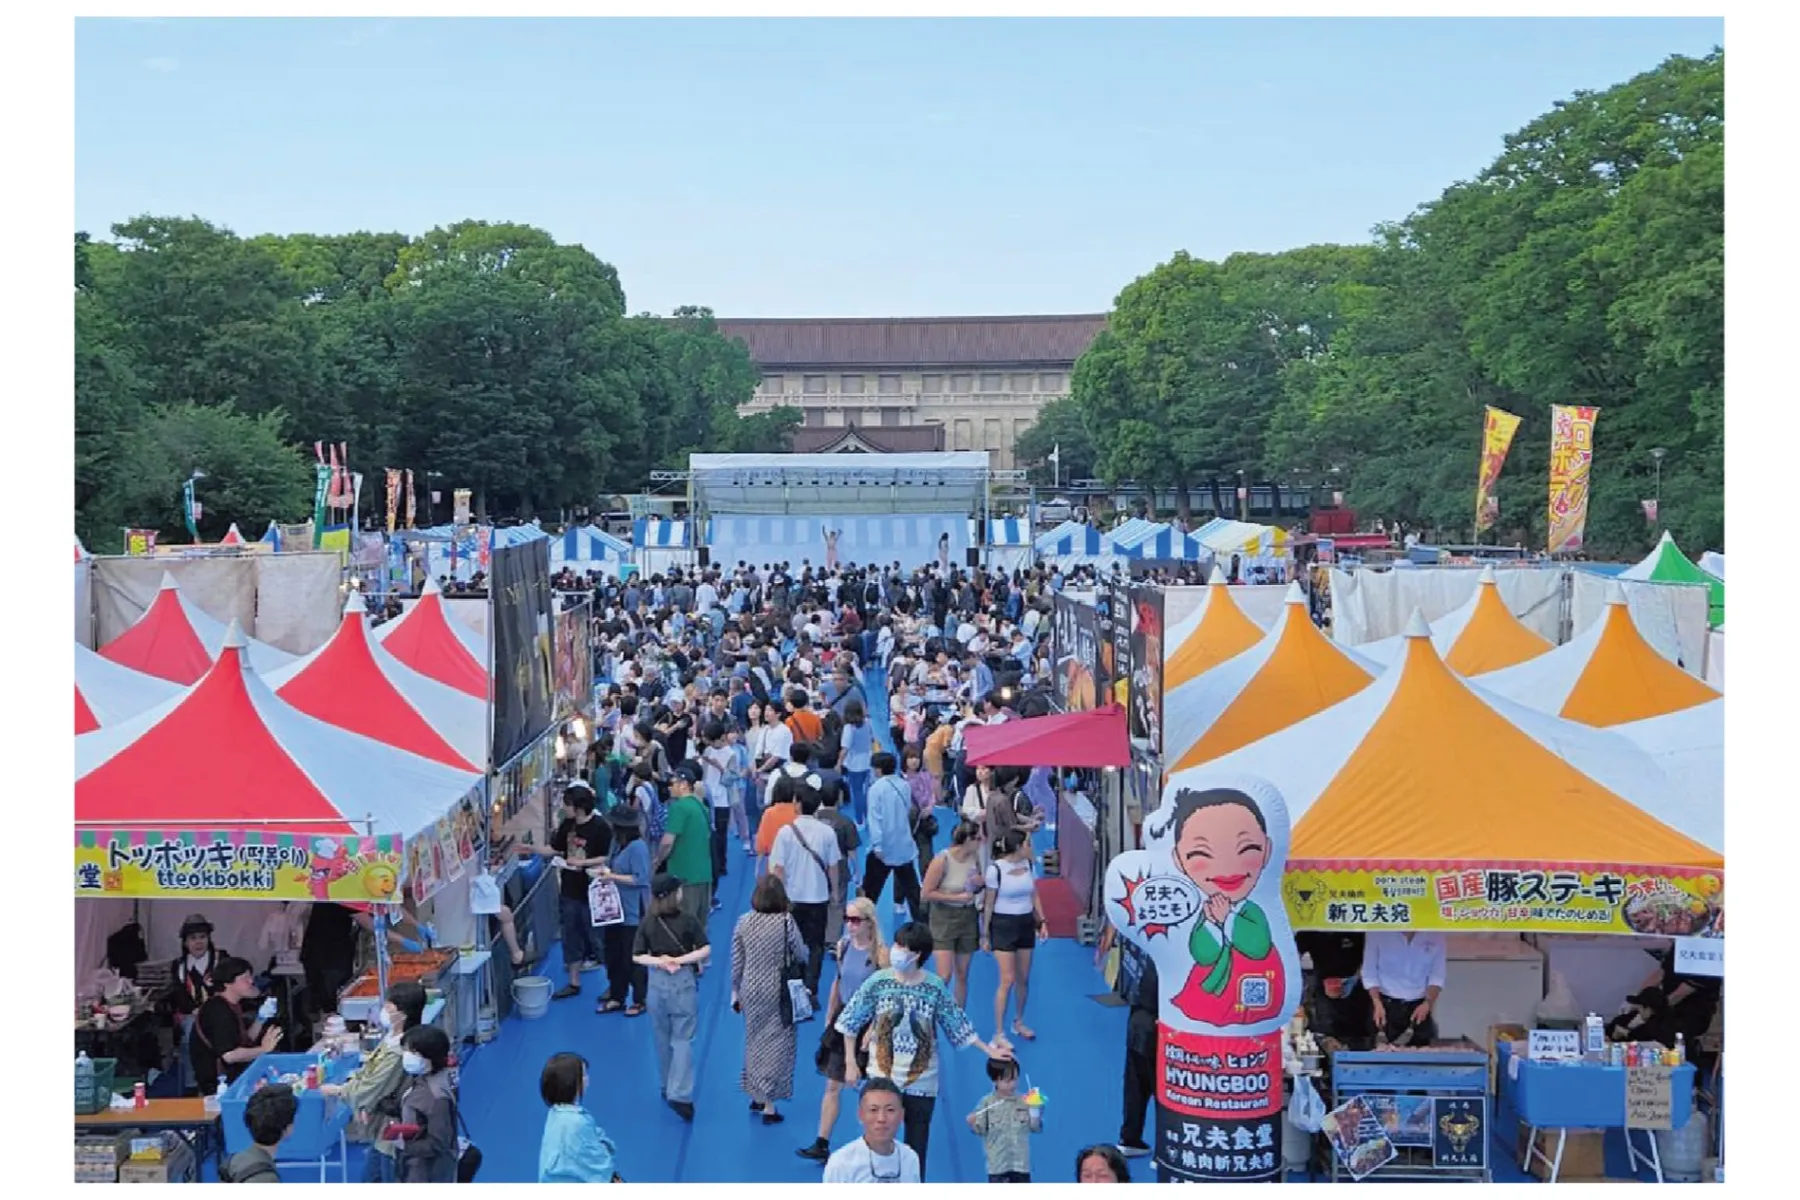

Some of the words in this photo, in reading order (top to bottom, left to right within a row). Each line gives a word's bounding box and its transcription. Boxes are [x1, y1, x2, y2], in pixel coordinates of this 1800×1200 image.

[157, 868, 275, 890] tteokbokki
[1437, 871, 1624, 904] 国産豚ステーキ
[1145, 885, 1188, 901] 兄夫へ
[1138, 901, 1191, 920] ようこそ!
[1165, 1064, 1269, 1093] HYUNGBOO
[1204, 1096, 1269, 1110] Restaurant
